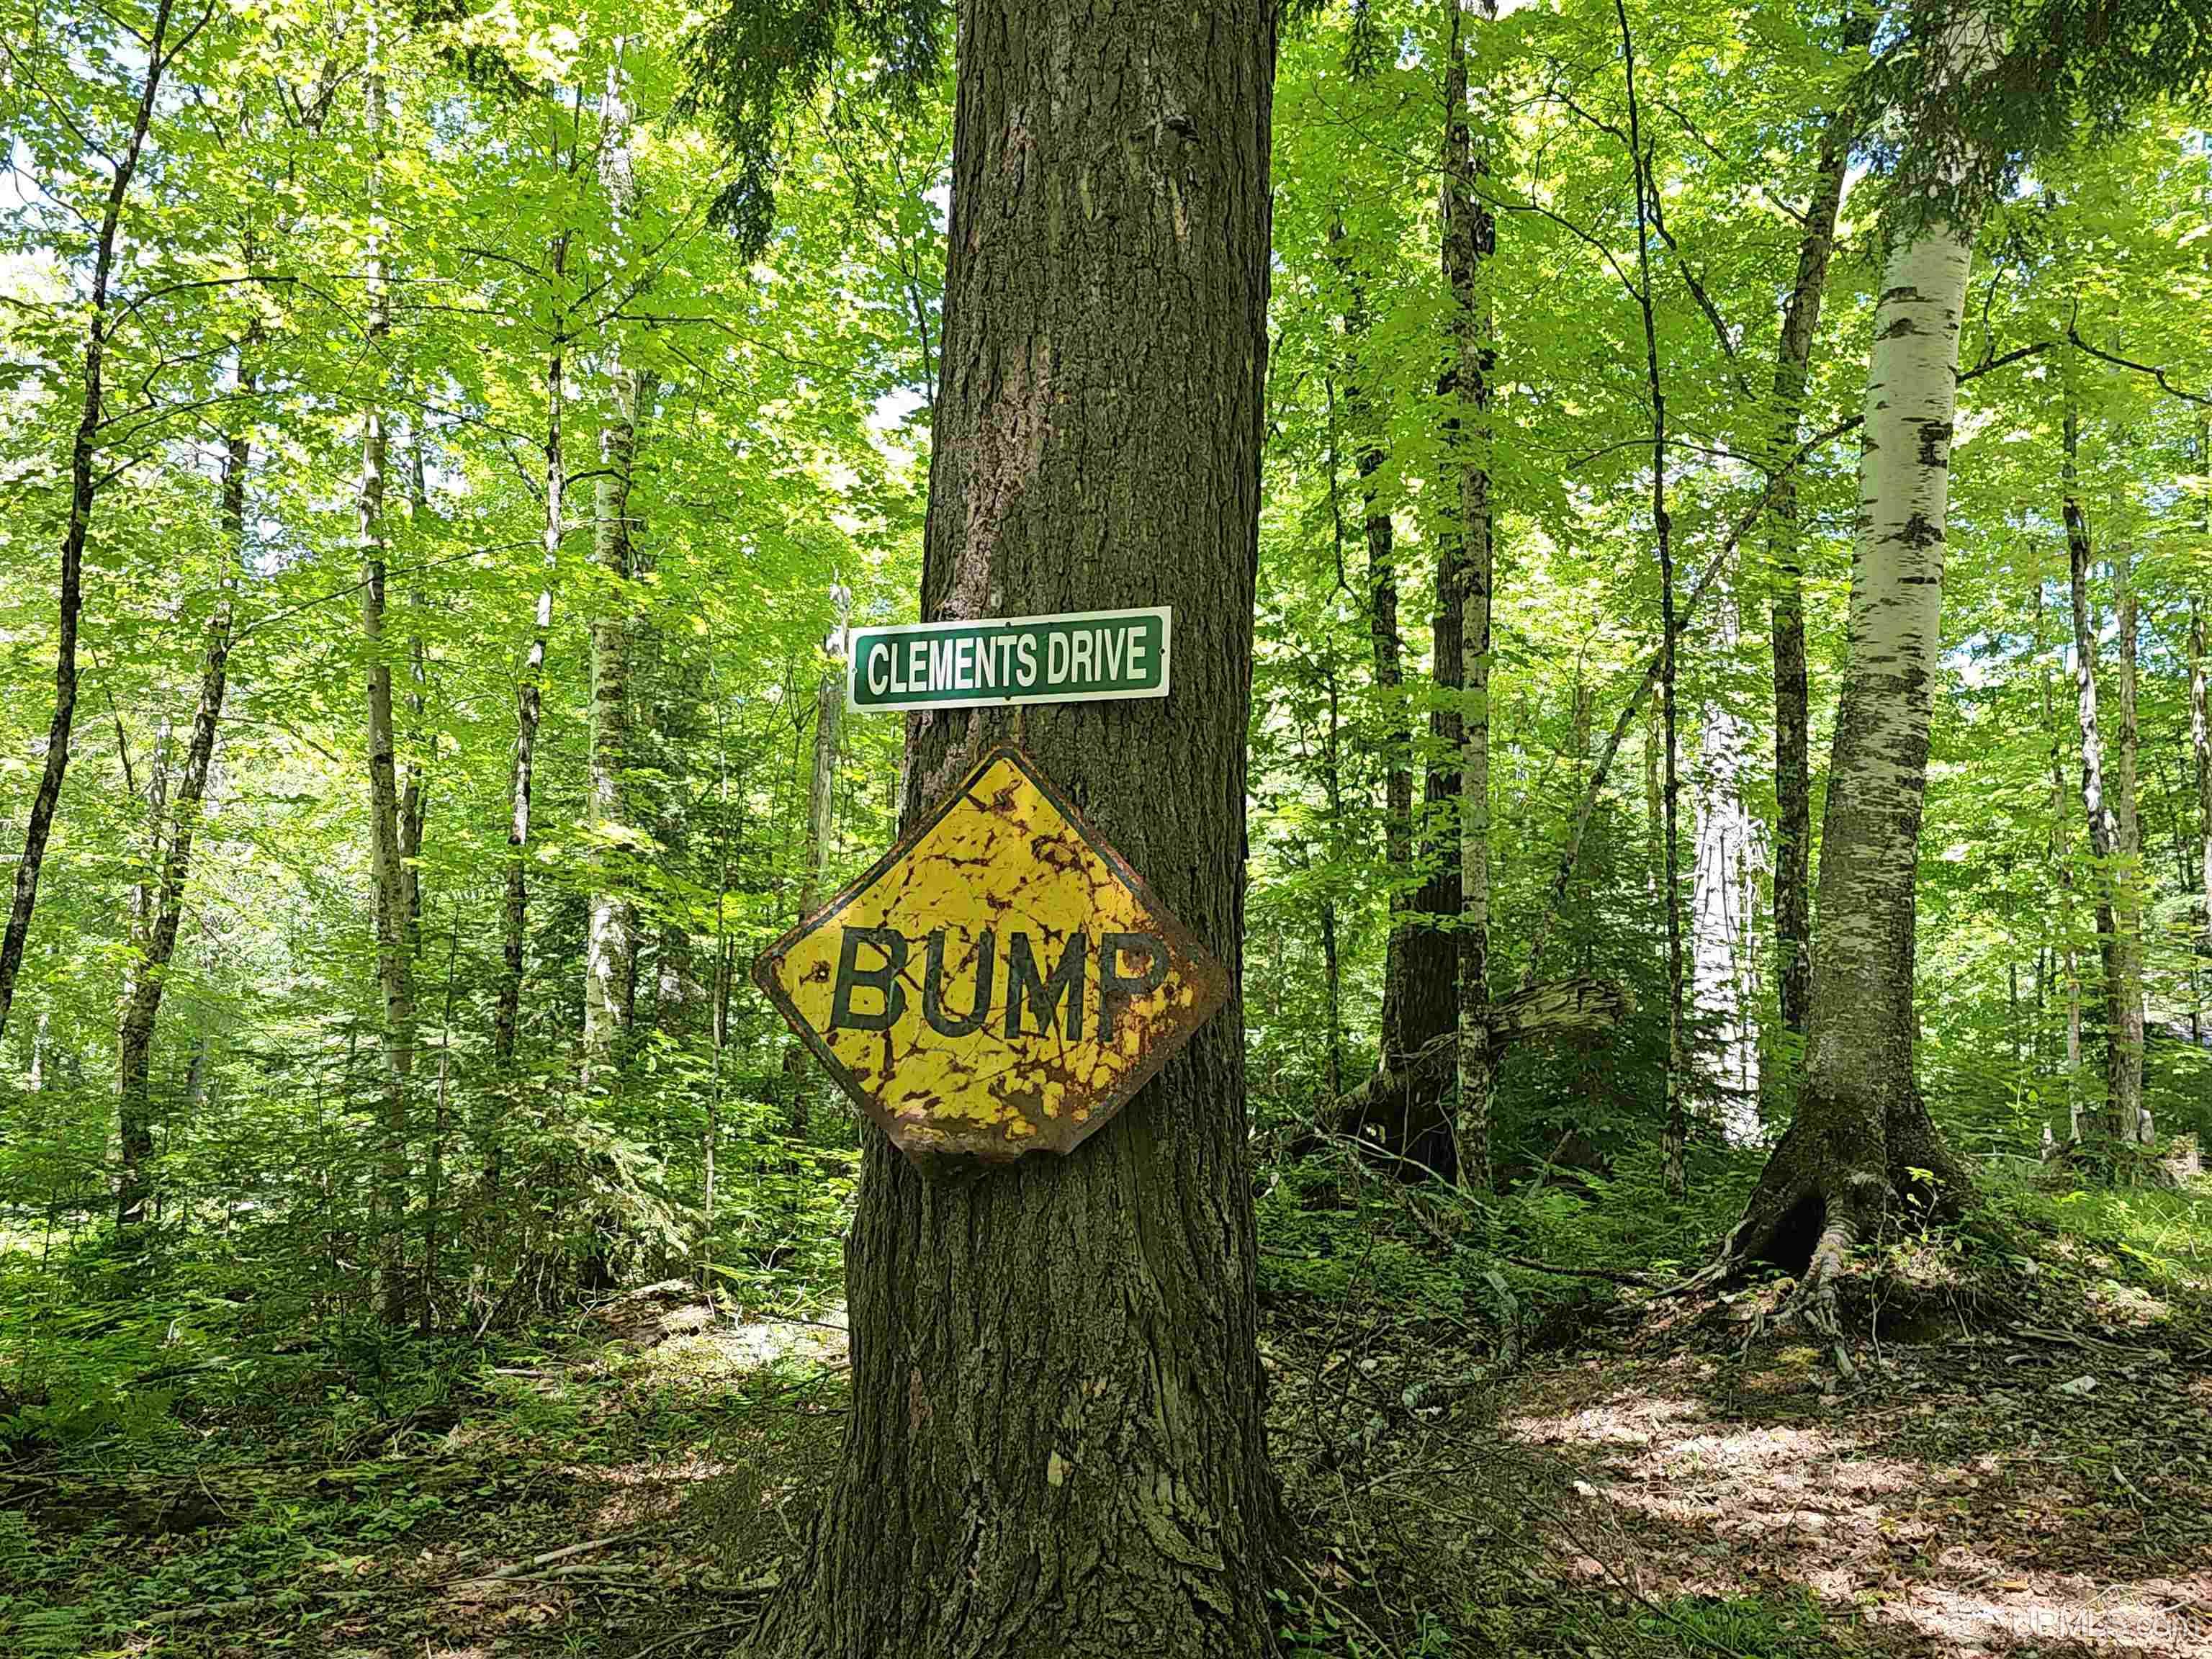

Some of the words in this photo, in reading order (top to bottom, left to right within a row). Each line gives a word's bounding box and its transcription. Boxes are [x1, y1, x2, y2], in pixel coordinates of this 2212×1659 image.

[868, 634, 1037, 696] CLEMENTS
[1048, 626, 1147, 685] DRIVE
[830, 925, 1169, 1043] BUMP
